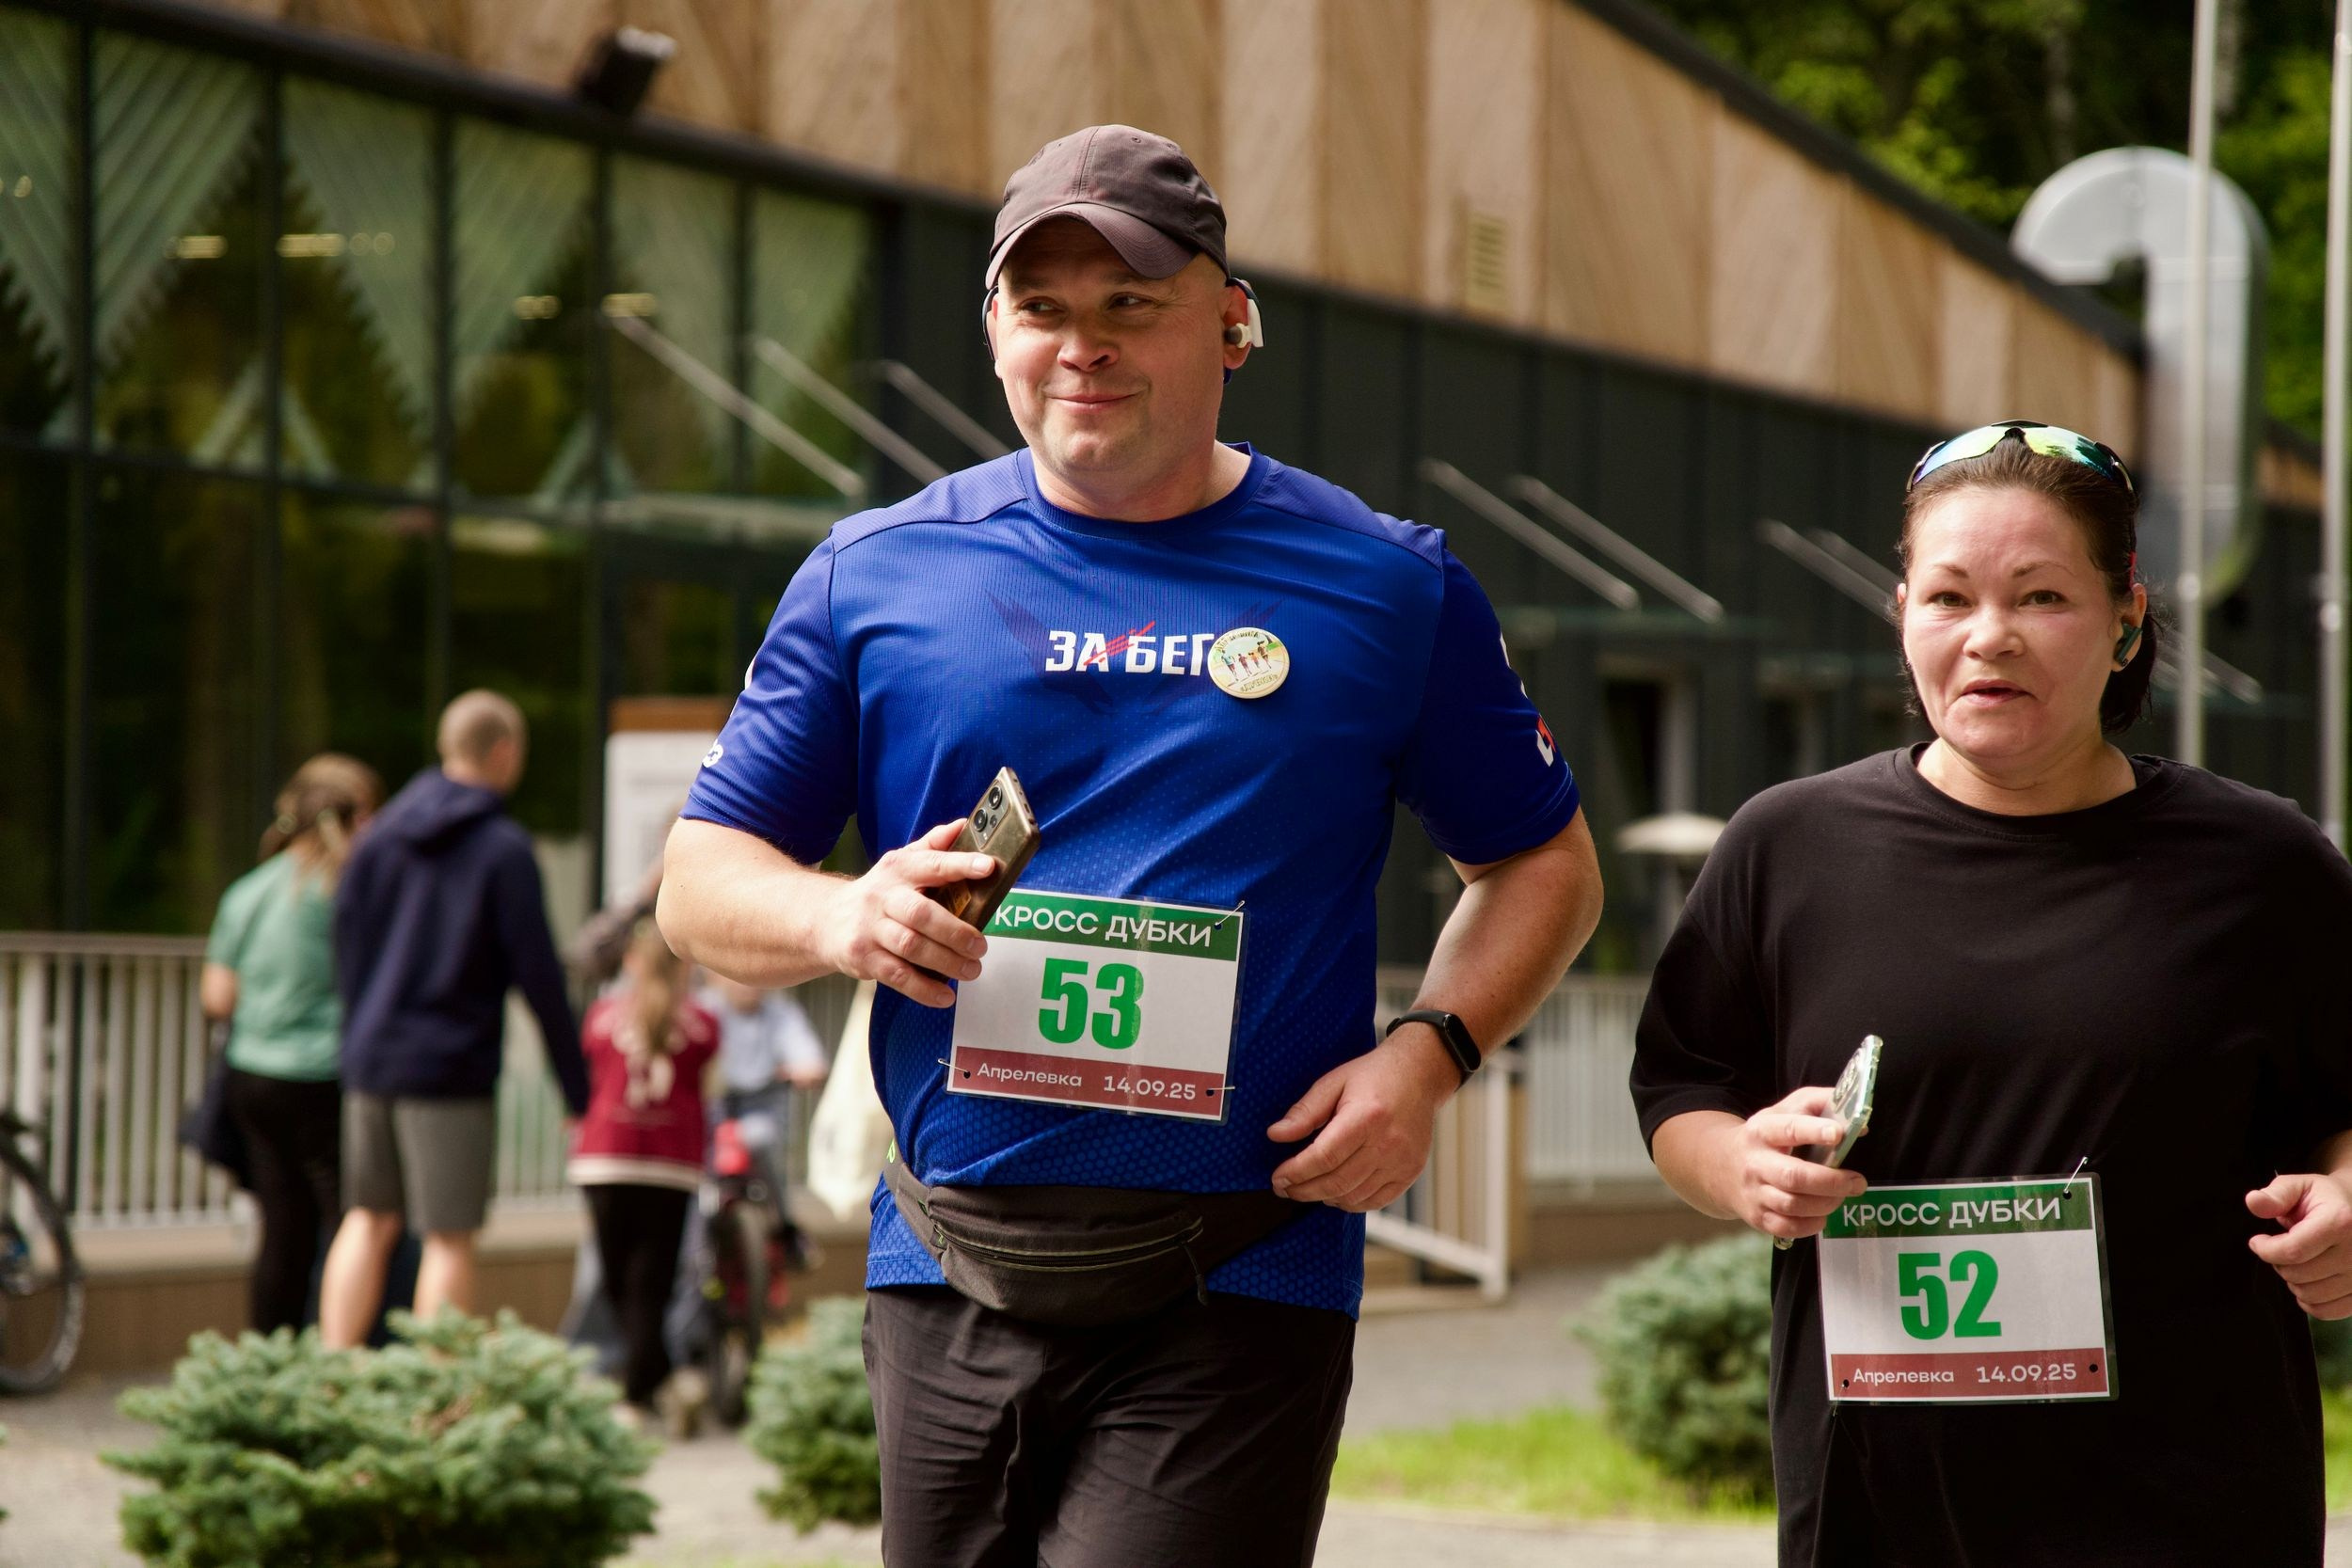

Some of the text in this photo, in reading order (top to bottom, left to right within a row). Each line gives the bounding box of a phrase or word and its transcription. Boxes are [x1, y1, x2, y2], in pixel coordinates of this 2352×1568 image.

[1045, 630, 1109, 672] ЗА
[1125, 633, 1215, 676] БЕГ
[994, 905, 1212, 947] КРОСС ДУБКИ
[1038, 958, 1145, 1050] 53
[977, 1063, 1196, 1101] Апрелевка 14.09.25
[1843, 1197, 2061, 1228] КРОСС ДУБКИ
[1898, 1249, 2002, 1340] 52
[1852, 1363, 2077, 1386] Апрелевка 14.09.25
